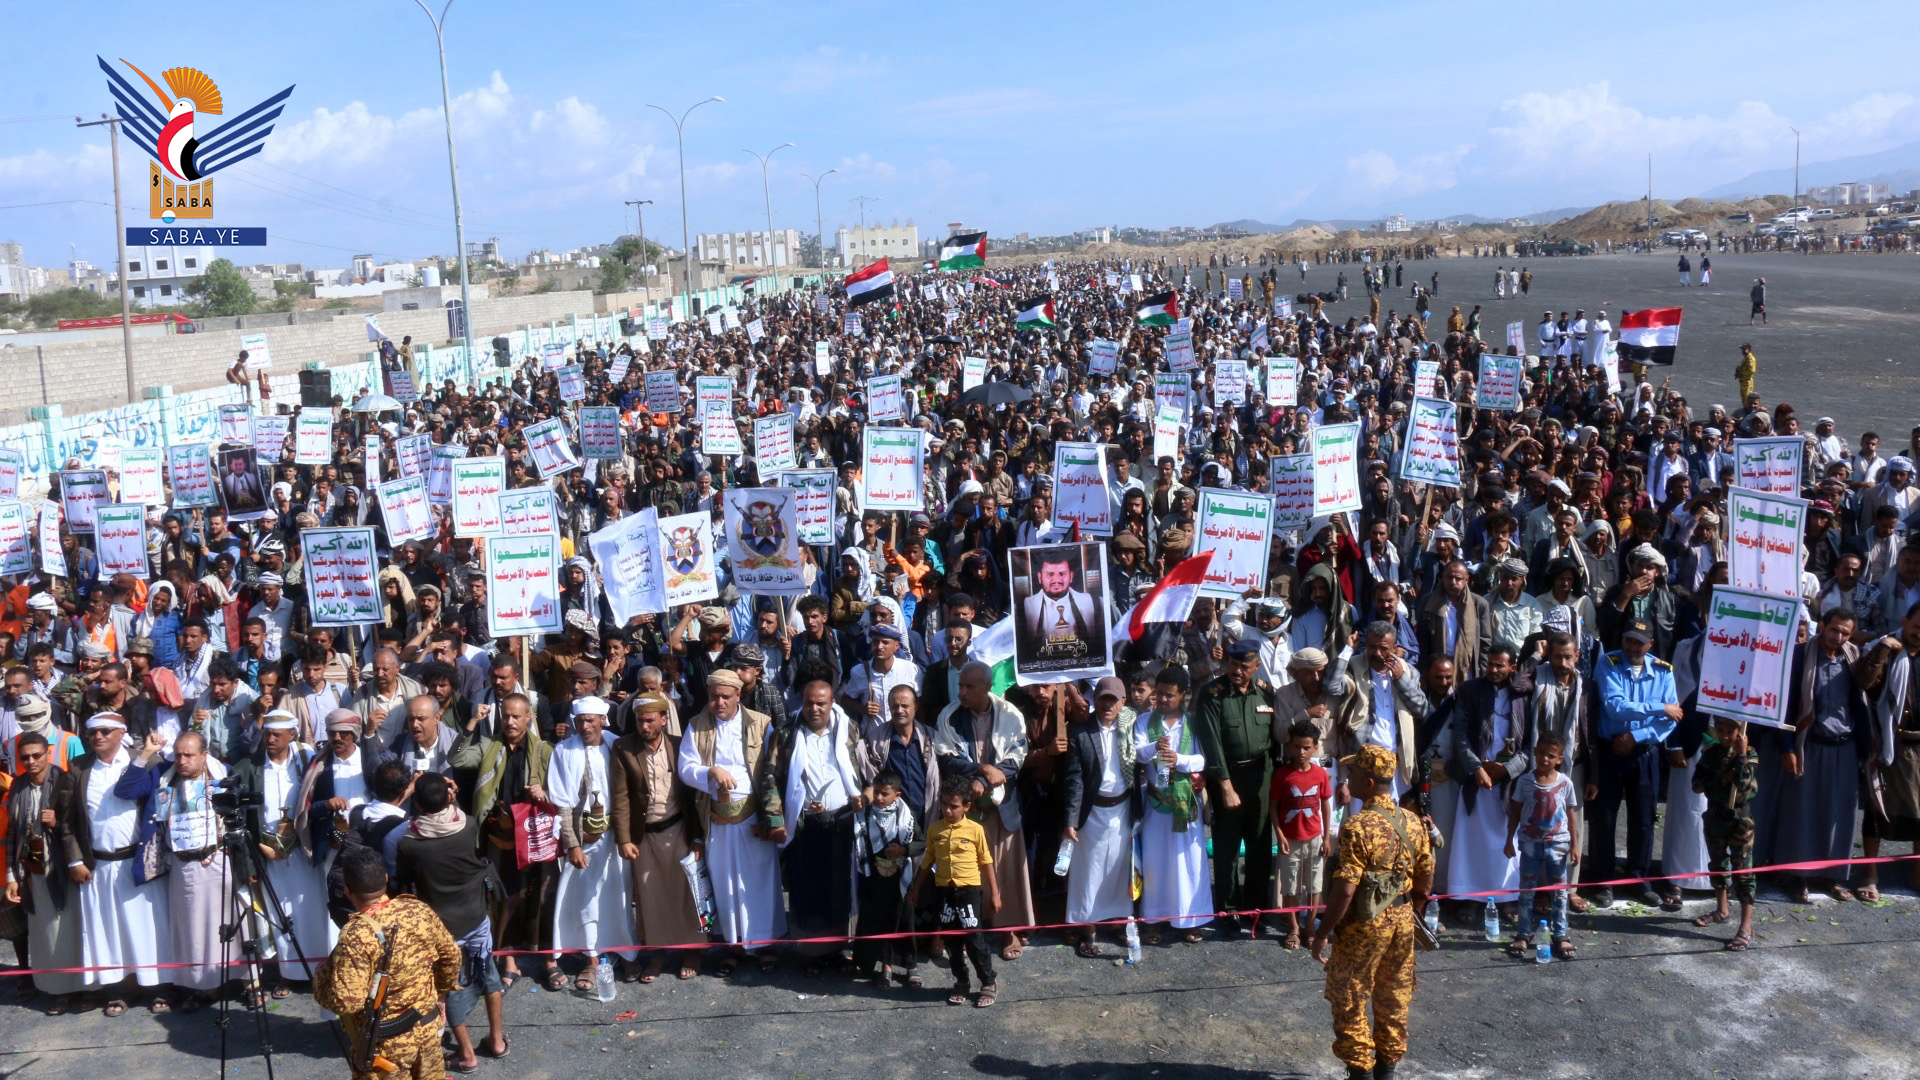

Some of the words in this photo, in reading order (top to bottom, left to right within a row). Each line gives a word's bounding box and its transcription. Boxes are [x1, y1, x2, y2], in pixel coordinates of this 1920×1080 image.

[1419, 405, 1449, 418] أكبر
[528, 424, 558, 440] قاطعوا
[1318, 428, 1354, 449] قاطعوا
[870, 434, 916, 448] قاطعوا
[869, 453, 893, 465] الأمريكية
[1741, 446, 1775, 465] أكبر
[1777, 446, 1797, 460] الله
[894, 455, 915, 466] البضائع
[1276, 459, 1304, 475] أكبر
[458, 466, 500, 481] قاطعوا
[890, 472, 893, 481] و
[1334, 473, 1337, 482] و
[1742, 466, 1772, 478] لأمريكا
[1774, 467, 1795, 476] الموت
[64, 475, 103, 488] قاطعوا
[814, 478, 831, 487] الله
[1061, 472, 1086, 487] الأمريكية
[382, 482, 420, 498] قاطعوا
[810, 491, 830, 499] الموت
[533, 496, 549, 507] الله
[1082, 493, 1085, 503] و
[478, 502, 480, 510] و
[504, 496, 530, 514] أكبر
[1207, 498, 1266, 518] قاطعوا
[2, 509, 19, 518] الله
[100, 509, 139, 524] قاطعوا
[531, 512, 551, 521] الموت
[1736, 501, 1797, 529] قاطعوا
[809, 527, 829, 539] النصر
[1204, 523, 1235, 539] الأمريكية
[1236, 526, 1264, 543] البضائع
[310, 535, 343, 555] أكبر
[347, 536, 368, 549] الله
[1736, 529, 1766, 549] الأمريكية
[1766, 536, 1794, 557] البضائع
[312, 554, 342, 567] لأمريكا
[494, 545, 550, 563] قاطعوا
[1228, 549, 1232, 560] و
[345, 557, 369, 567] الموت
[1760, 561, 1765, 574] و
[315, 571, 344, 583] لإسرائيل
[347, 572, 371, 582] الموت
[495, 568, 524, 581] الأمريكية
[526, 567, 550, 580] البضائع
[1204, 570, 1259, 588] الإسرائيلي
[317, 588, 338, 599] اليهود
[341, 588, 352, 598] على
[355, 587, 373, 596] اللعنة
[522, 588, 525, 597] و
[318, 602, 347, 618] للإسلام
[352, 601, 376, 616] النصر
[497, 604, 552, 620] الإسرائيلية
[1713, 596, 1790, 625] قاطعوا
[1708, 627, 1750, 648] الأمريكية
[1750, 634, 1783, 656] البضائع
[1739, 660, 1745, 674] و
[1702, 681, 1776, 710] الإسرائيلية
